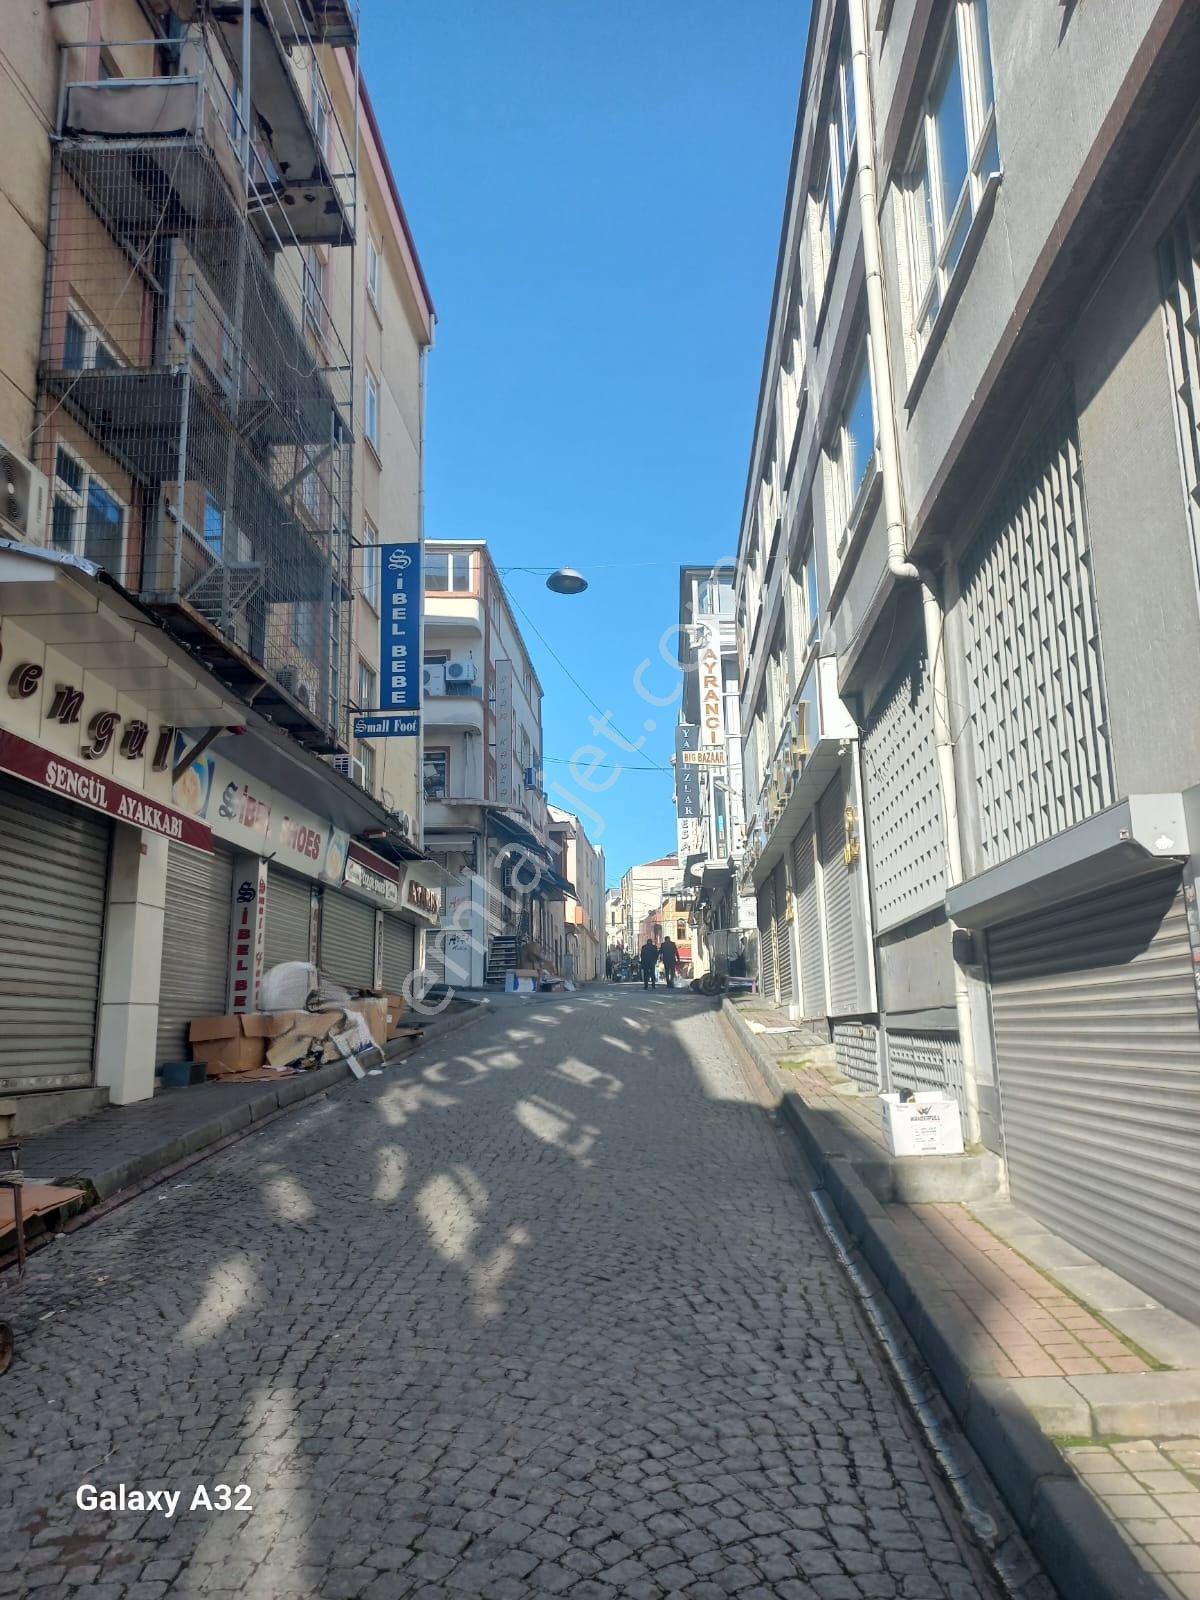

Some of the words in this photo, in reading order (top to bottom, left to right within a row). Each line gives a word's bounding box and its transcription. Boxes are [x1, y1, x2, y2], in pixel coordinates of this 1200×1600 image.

[391, 645, 408, 704] BEBE
[702, 648, 720, 744] AYRANCI
[355, 719, 390, 735] Small
[393, 718, 417, 733] Foot
[684, 752, 697, 763] BIG
[697, 750, 725, 764] BAZAAR
[46, 760, 108, 809] ŞENGÜL
[117, 793, 182, 839] AYAKKABI
[681, 729, 694, 815] YAUZLAR
